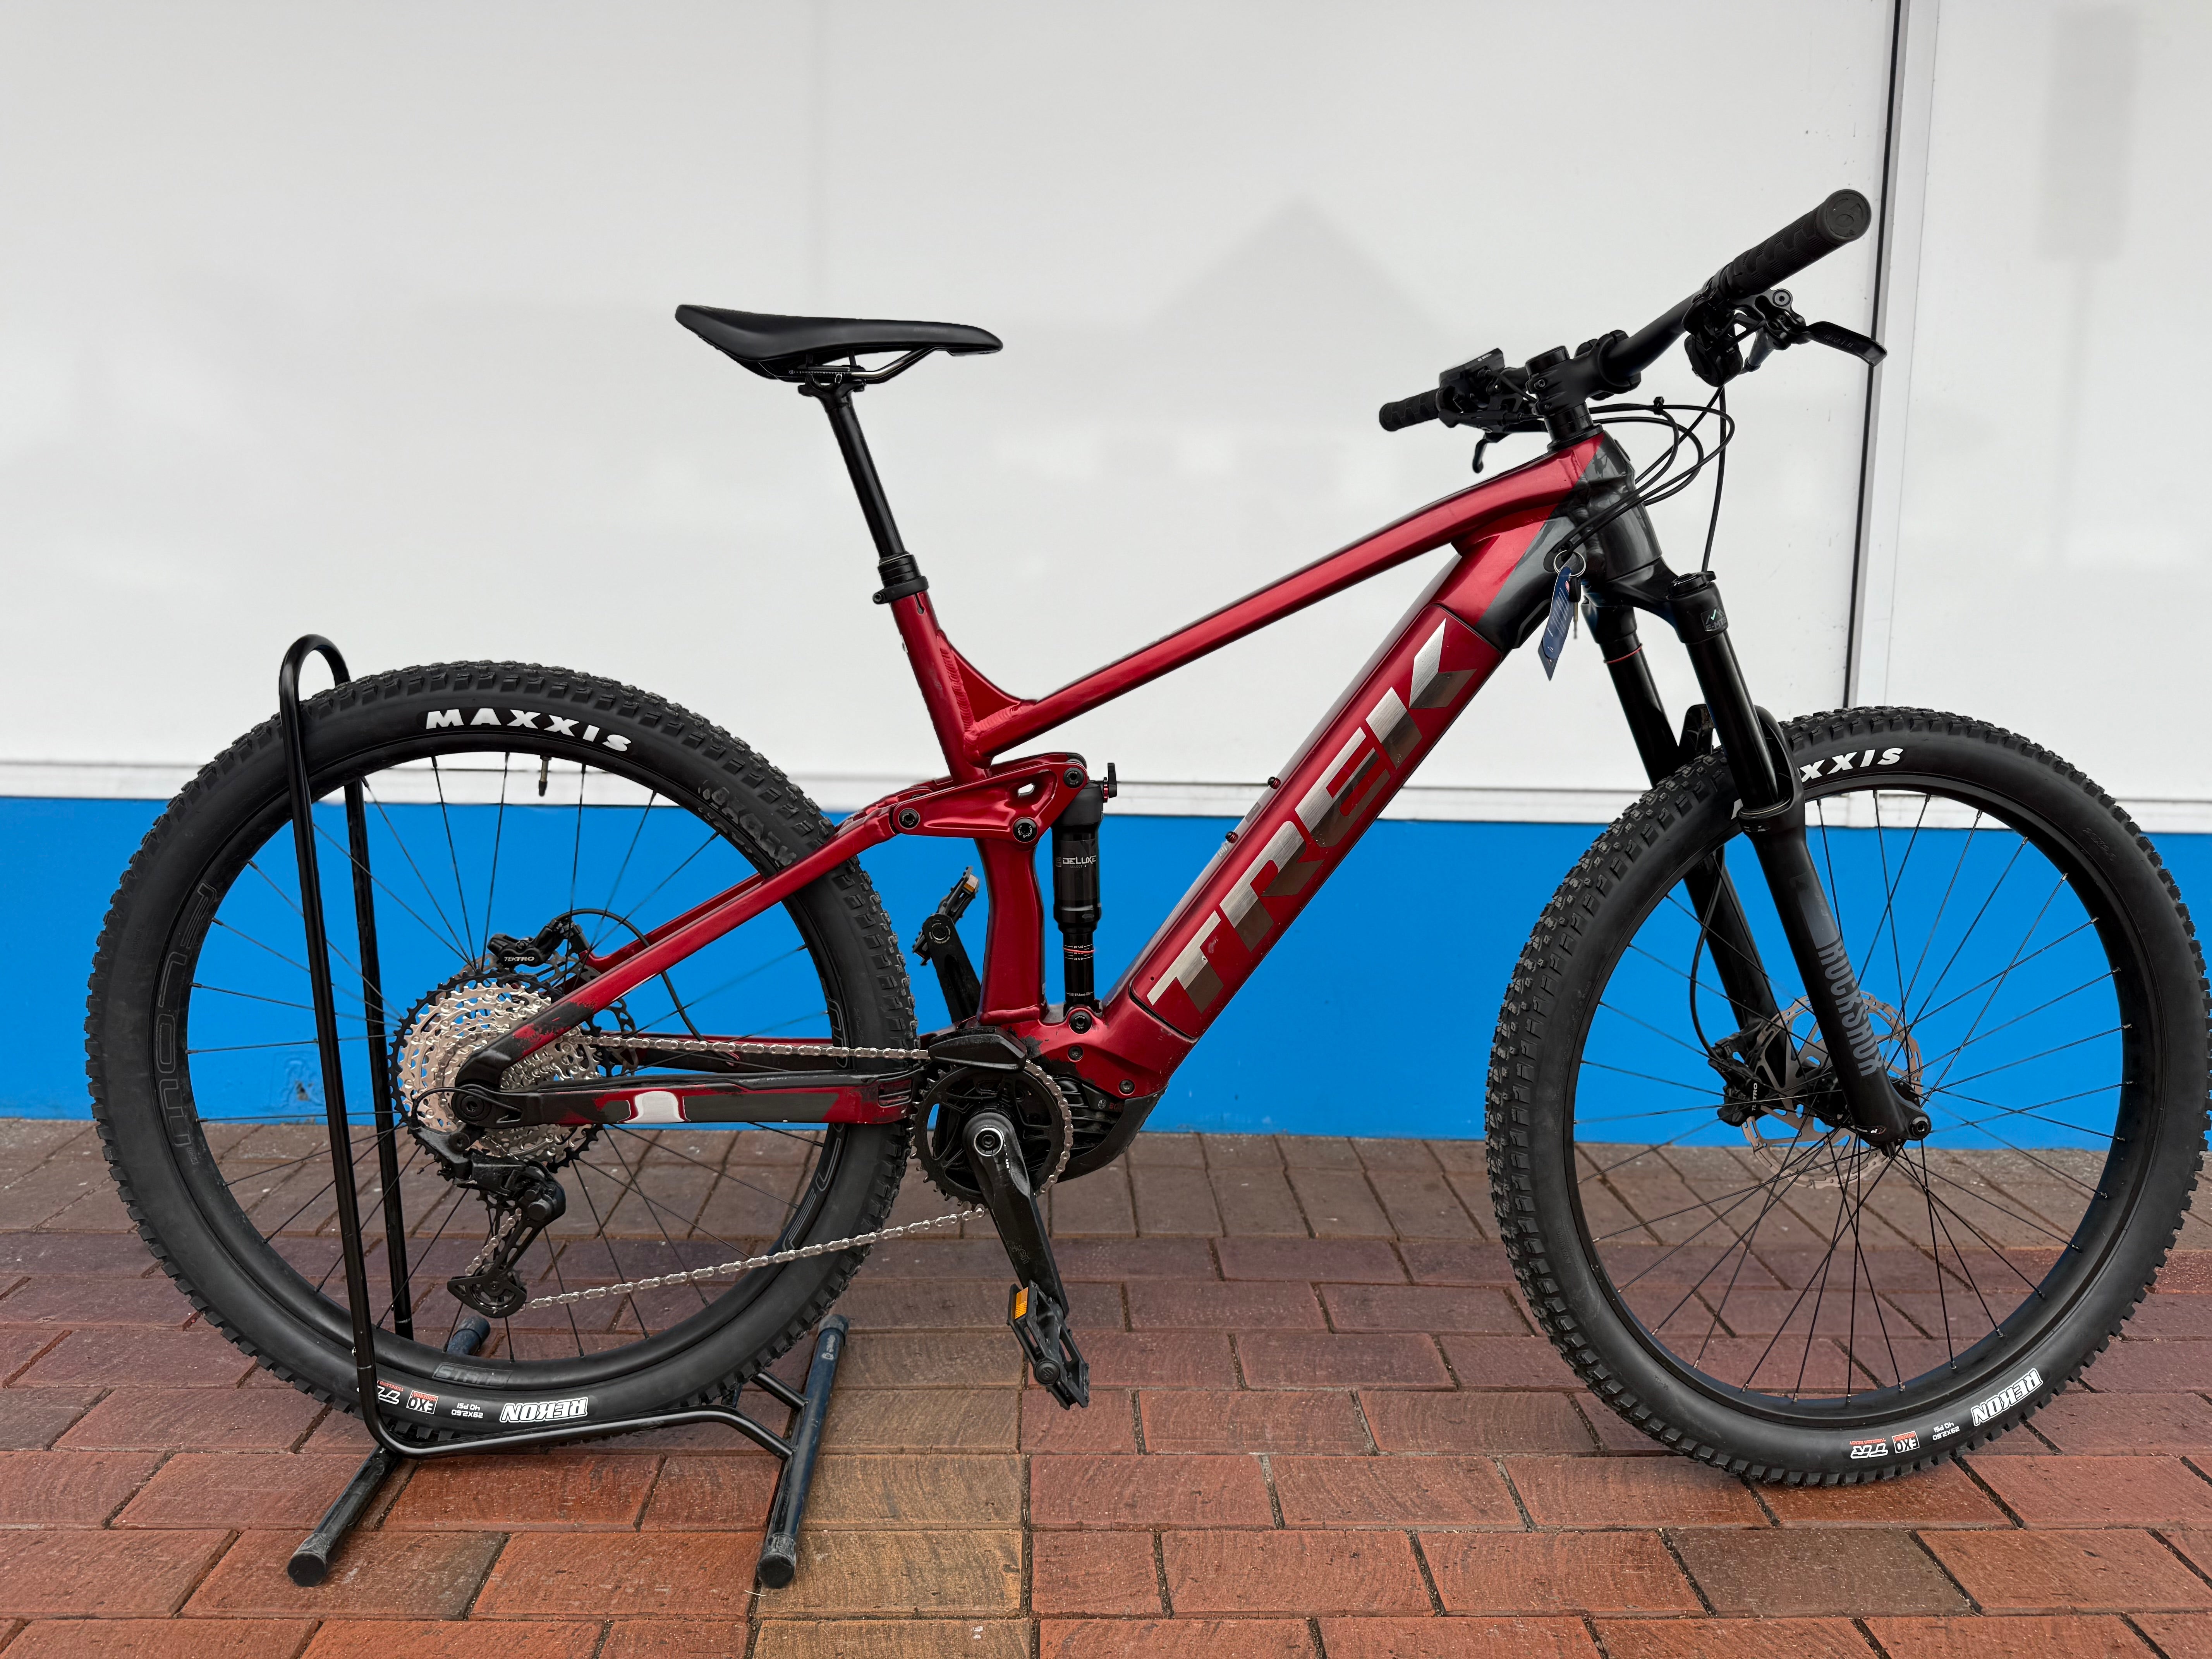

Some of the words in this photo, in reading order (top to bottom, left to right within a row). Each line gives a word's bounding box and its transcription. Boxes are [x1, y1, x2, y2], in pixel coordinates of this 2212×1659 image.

[426, 708, 632, 752] MAXXIS
[1802, 748, 1904, 783] XXIS
[1147, 618, 1477, 1013] TREK
[1063, 855, 1097, 865] DELUXE
[409, 1397, 434, 1412] EXO
[1971, 1368, 2044, 1427] REKON
[500, 1397, 589, 1422] REKON
[1934, 1424, 1944, 1433] PSI
[1850, 1443, 1889, 1459] TR
[1896, 1439, 1918, 1453] EXO
